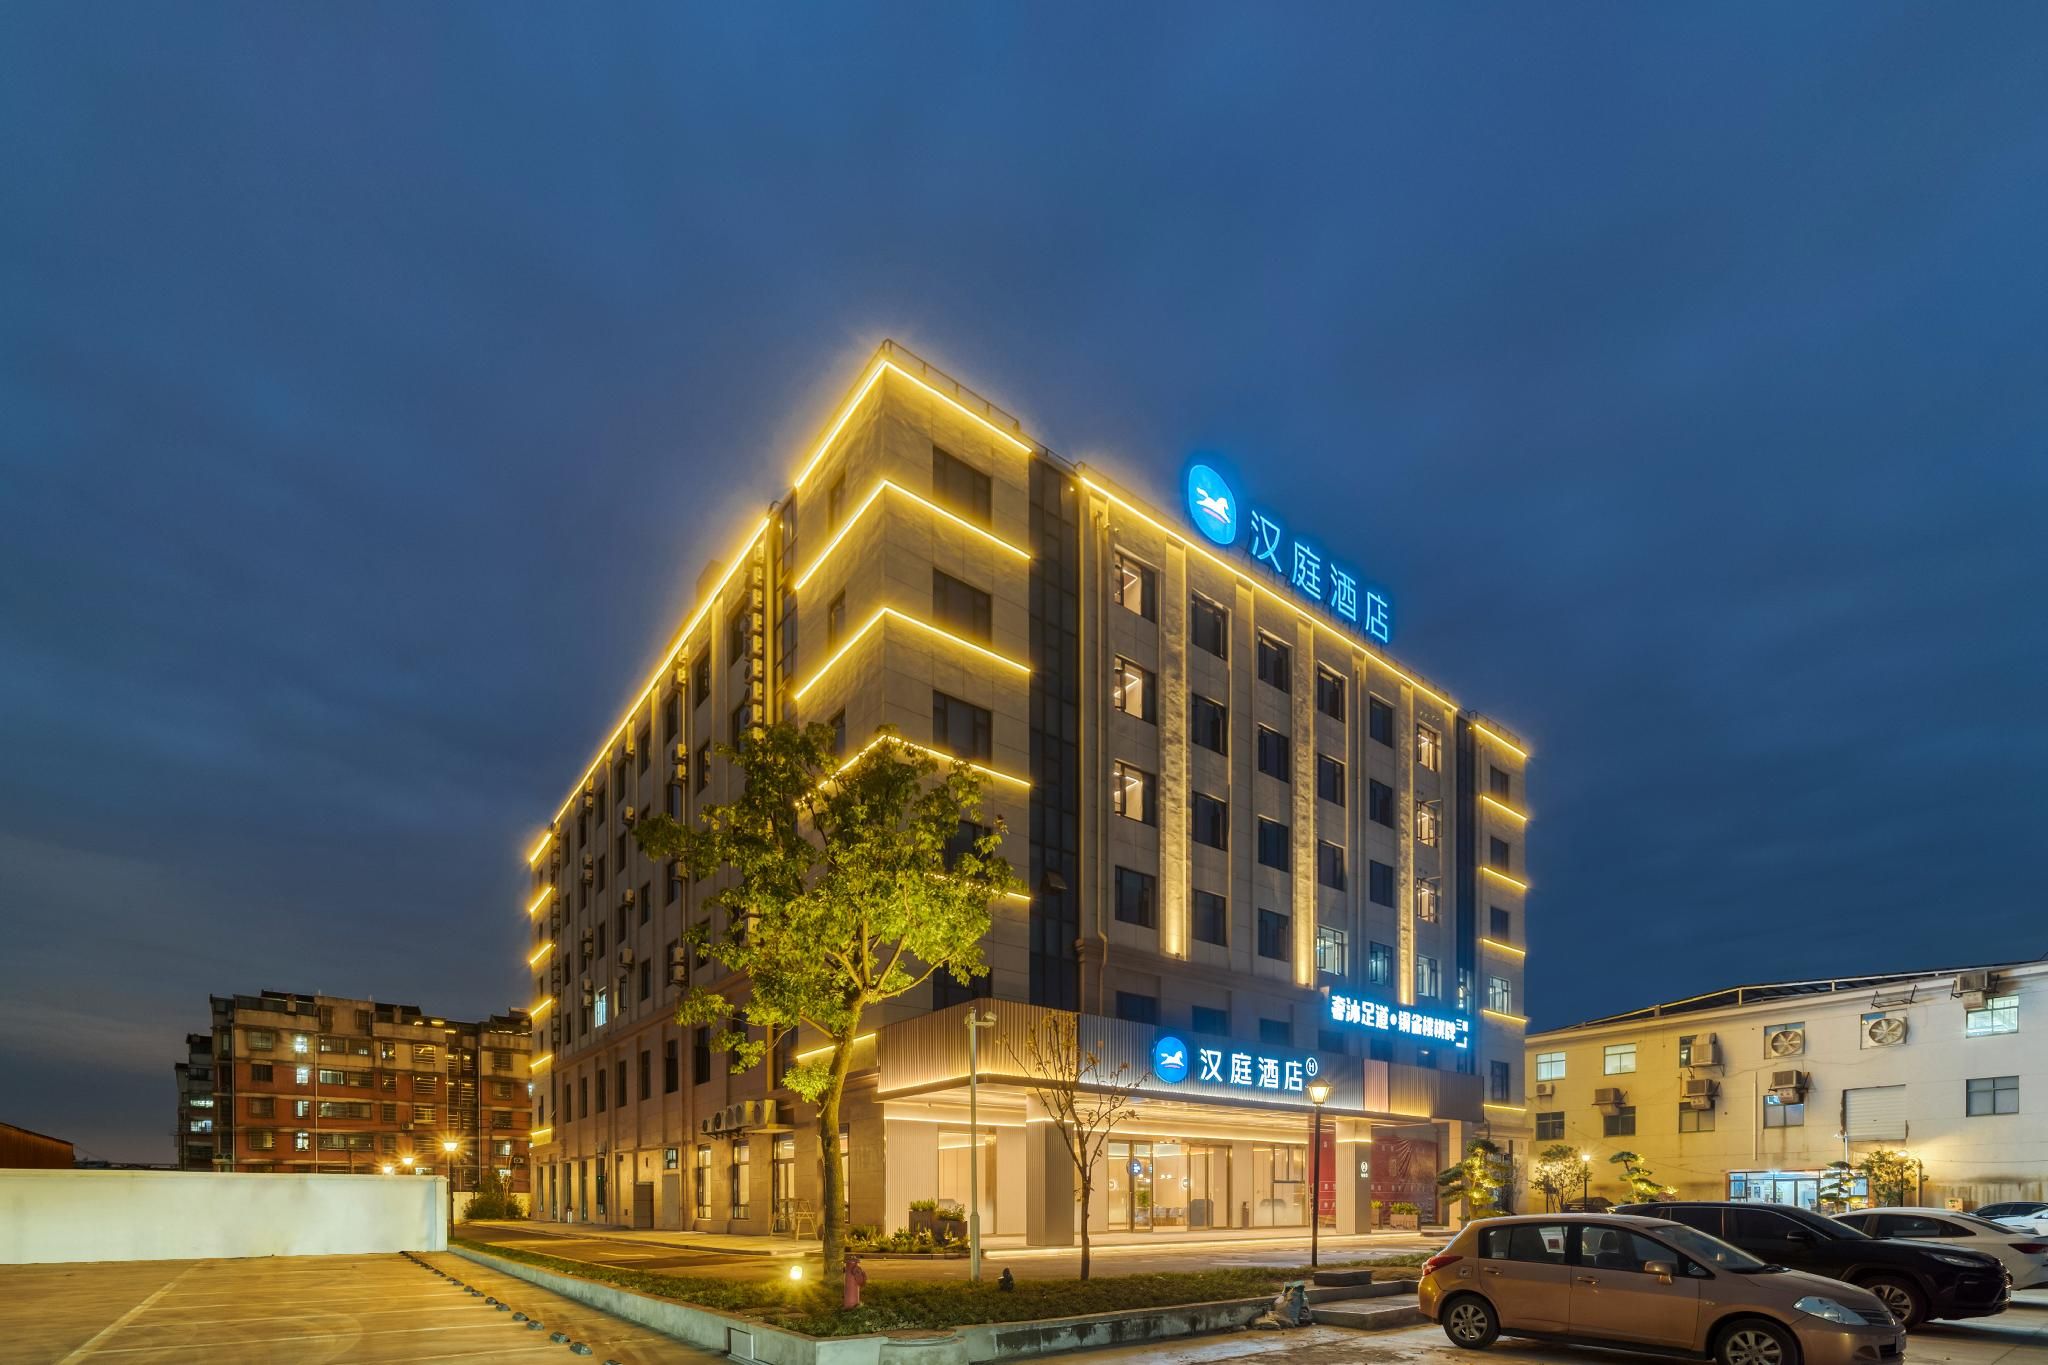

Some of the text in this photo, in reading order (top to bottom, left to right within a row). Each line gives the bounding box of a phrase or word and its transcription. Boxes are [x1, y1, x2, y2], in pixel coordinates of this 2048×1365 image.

[1250, 509, 1388, 643] 汉庭酒店
[1200, 1048, 1303, 1092] 汉庭酒店
